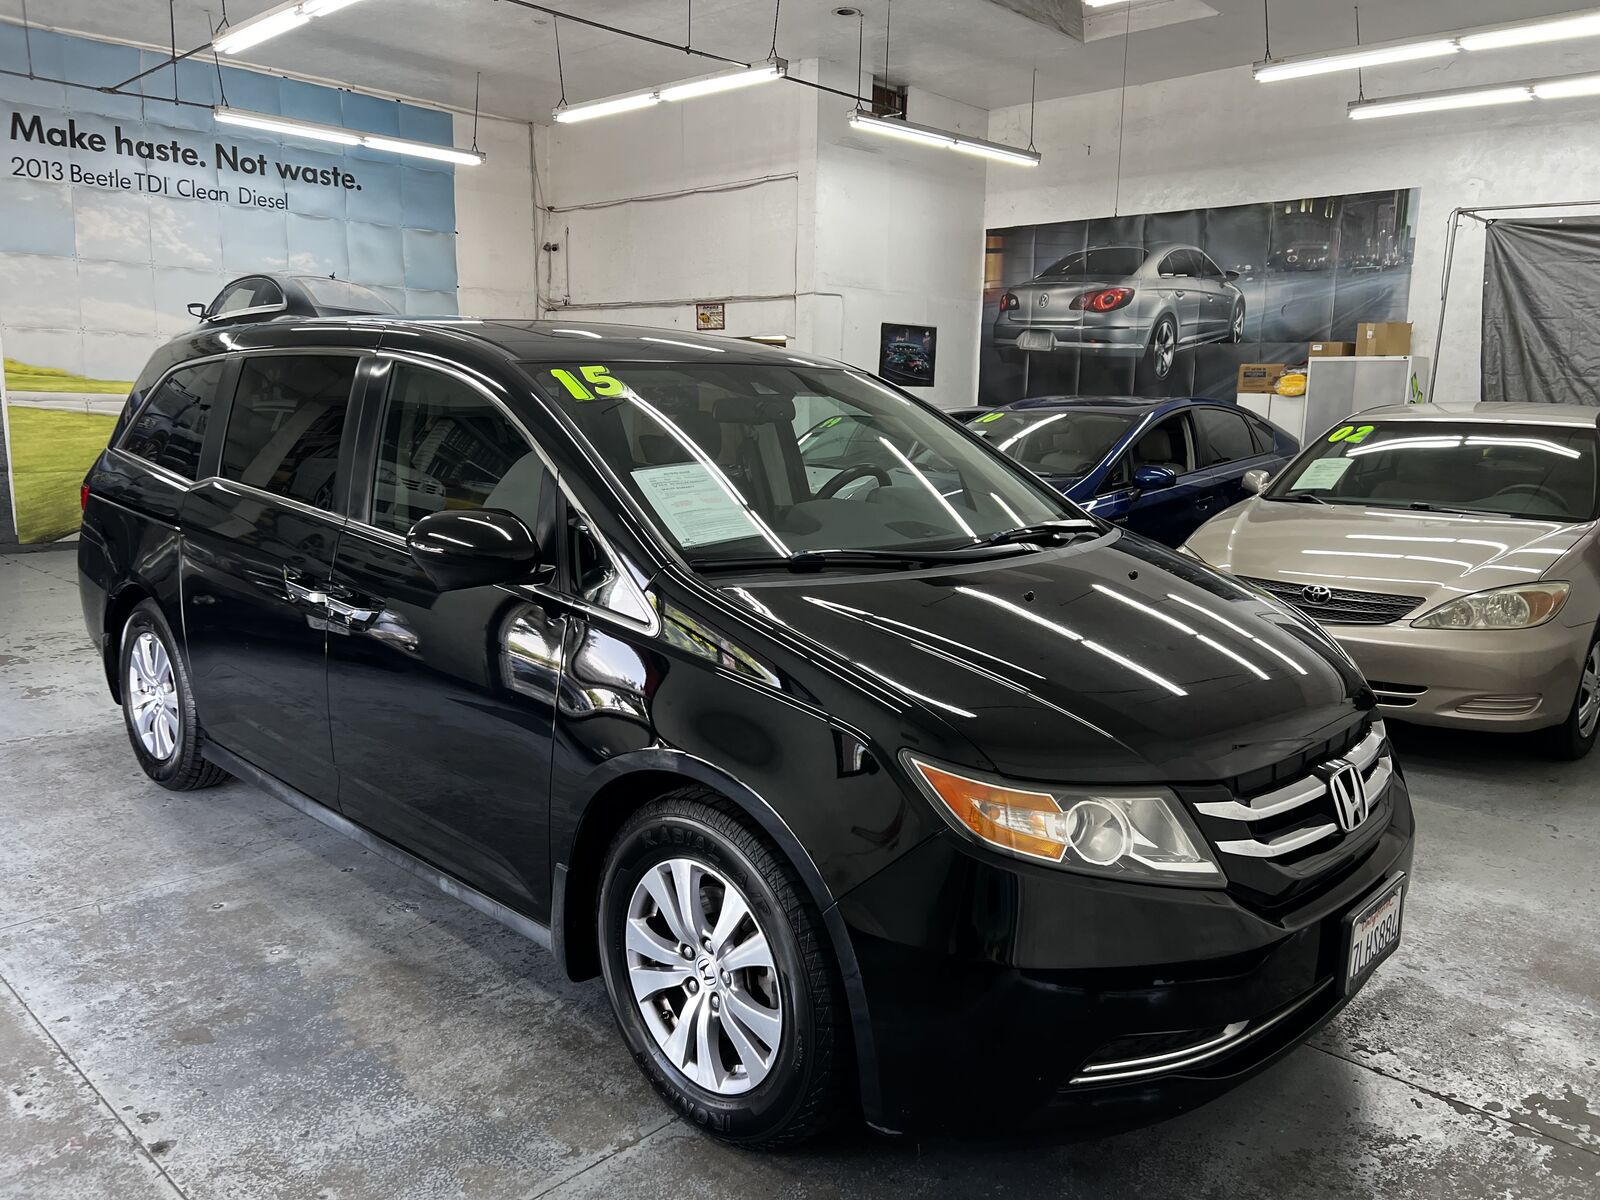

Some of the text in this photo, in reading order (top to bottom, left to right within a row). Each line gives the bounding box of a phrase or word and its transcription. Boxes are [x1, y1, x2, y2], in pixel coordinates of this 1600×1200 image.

[10, 112, 363, 191] Make haste. Not waste.
[11, 156, 65, 181] 2013
[70, 163, 132, 190] Beetle
[177, 179, 229, 202] Clean
[239, 186, 289, 210] Diesel
[550, 365, 627, 400] 15
[1327, 425, 1375, 444] 02
